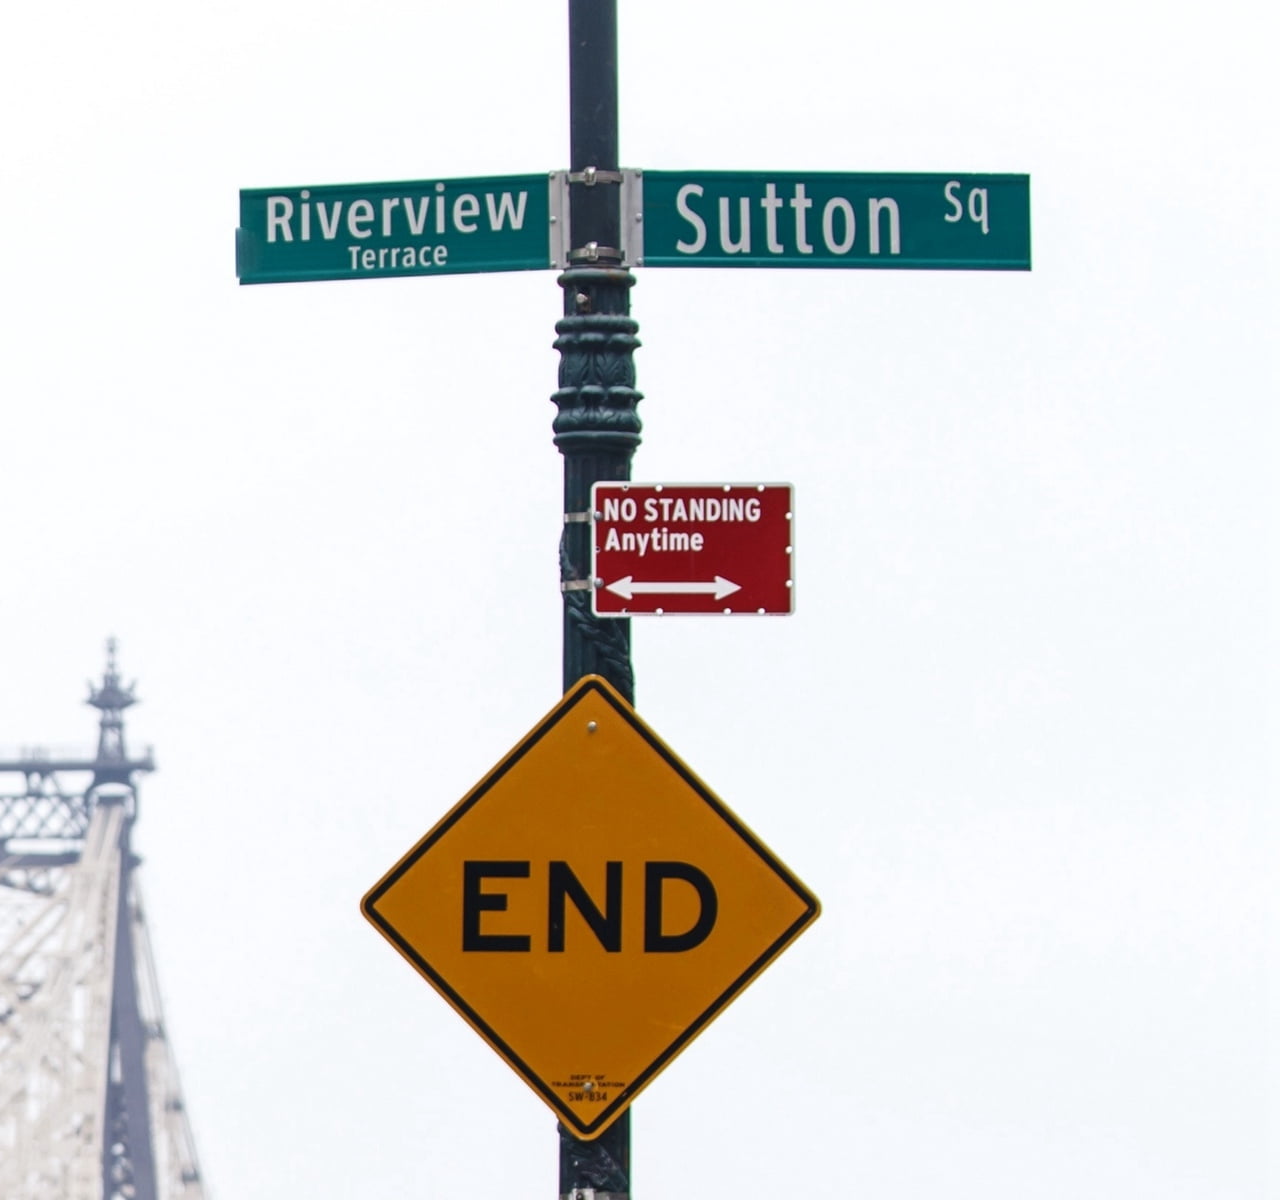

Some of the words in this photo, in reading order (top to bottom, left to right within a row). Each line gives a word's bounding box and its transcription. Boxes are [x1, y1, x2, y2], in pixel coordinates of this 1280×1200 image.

[266, 182, 528, 243] Riverview
[675, 182, 901, 255] Sutton
[943, 180, 990, 235] Sq
[347, 245, 448, 270] Terrace
[603, 498, 637, 522] NO
[643, 498, 761, 522] STANDING
[604, 527, 705, 557] Anytime
[461, 860, 719, 953] END
